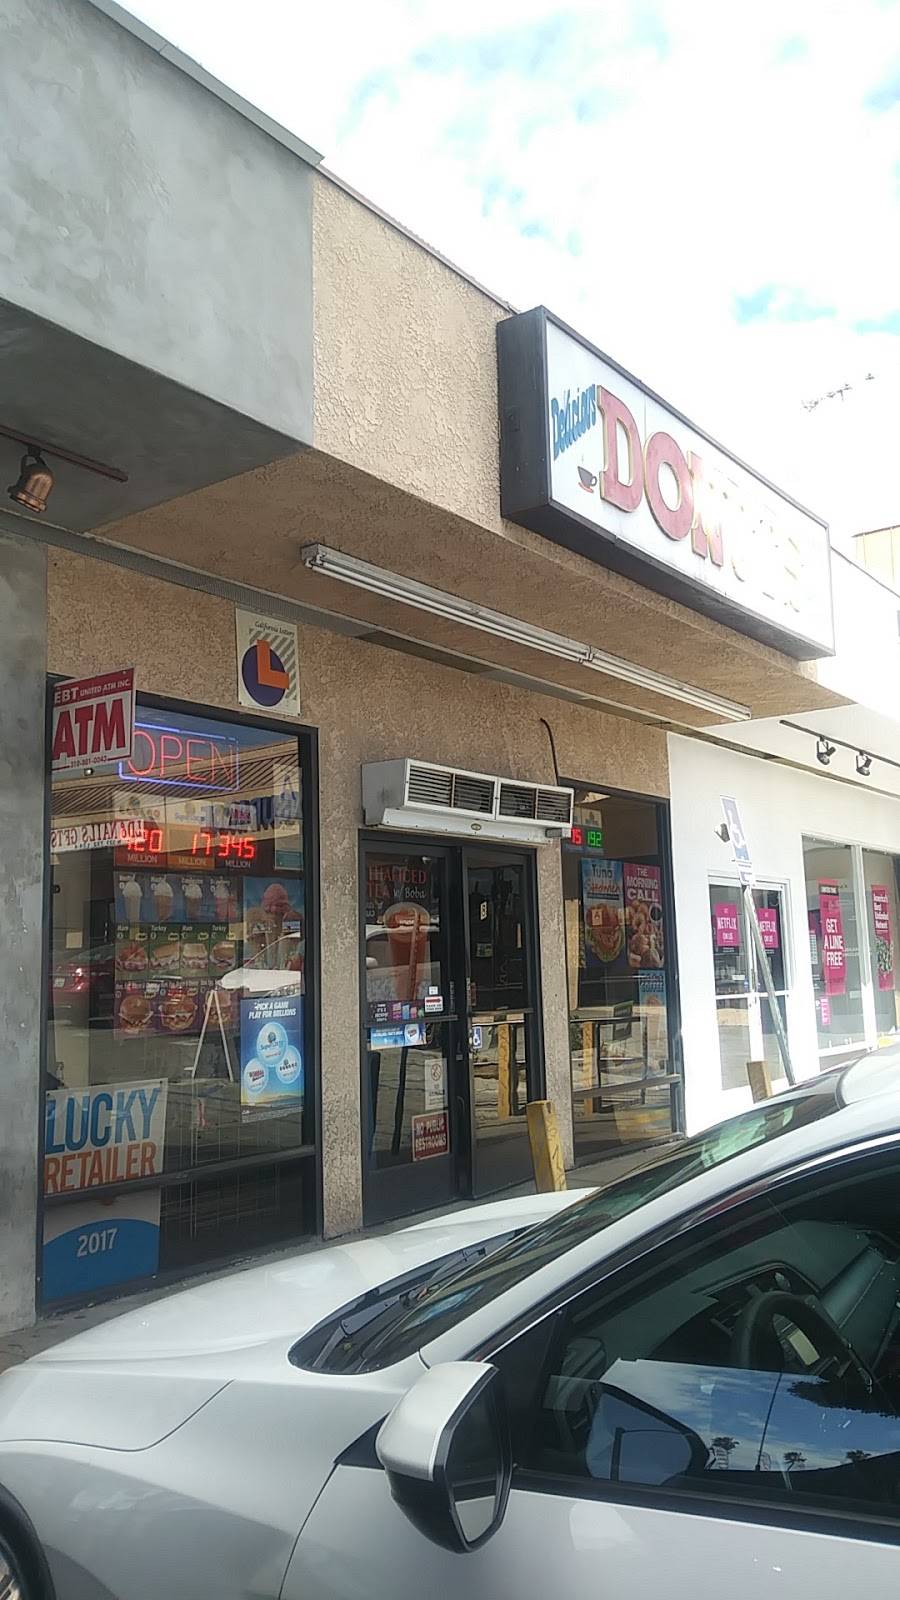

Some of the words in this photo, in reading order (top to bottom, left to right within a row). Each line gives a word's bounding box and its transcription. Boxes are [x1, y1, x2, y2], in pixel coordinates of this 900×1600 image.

[54, 687, 79, 704] EBT
[80, 686, 101, 697] UNITED
[102, 682, 116, 692] ATM
[52, 699, 126, 760] ATM
[127, 730, 234, 784] OPEN
[128, 854, 158, 864] MILLION
[179, 855, 206, 865] MILLION
[226, 859, 251, 868] MILLION
[627, 888, 658, 902] CALL
[717, 917, 737, 930] NETFLIX
[826, 919, 838, 933] GET
[824, 935, 829, 950] A
[830, 935, 844, 950] LINE
[827, 951, 843, 967] FREE
[45, 1088, 161, 1155] LUCKY
[44, 1142, 157, 1195] RETAILER
[76, 1228, 118, 1258] 2017
